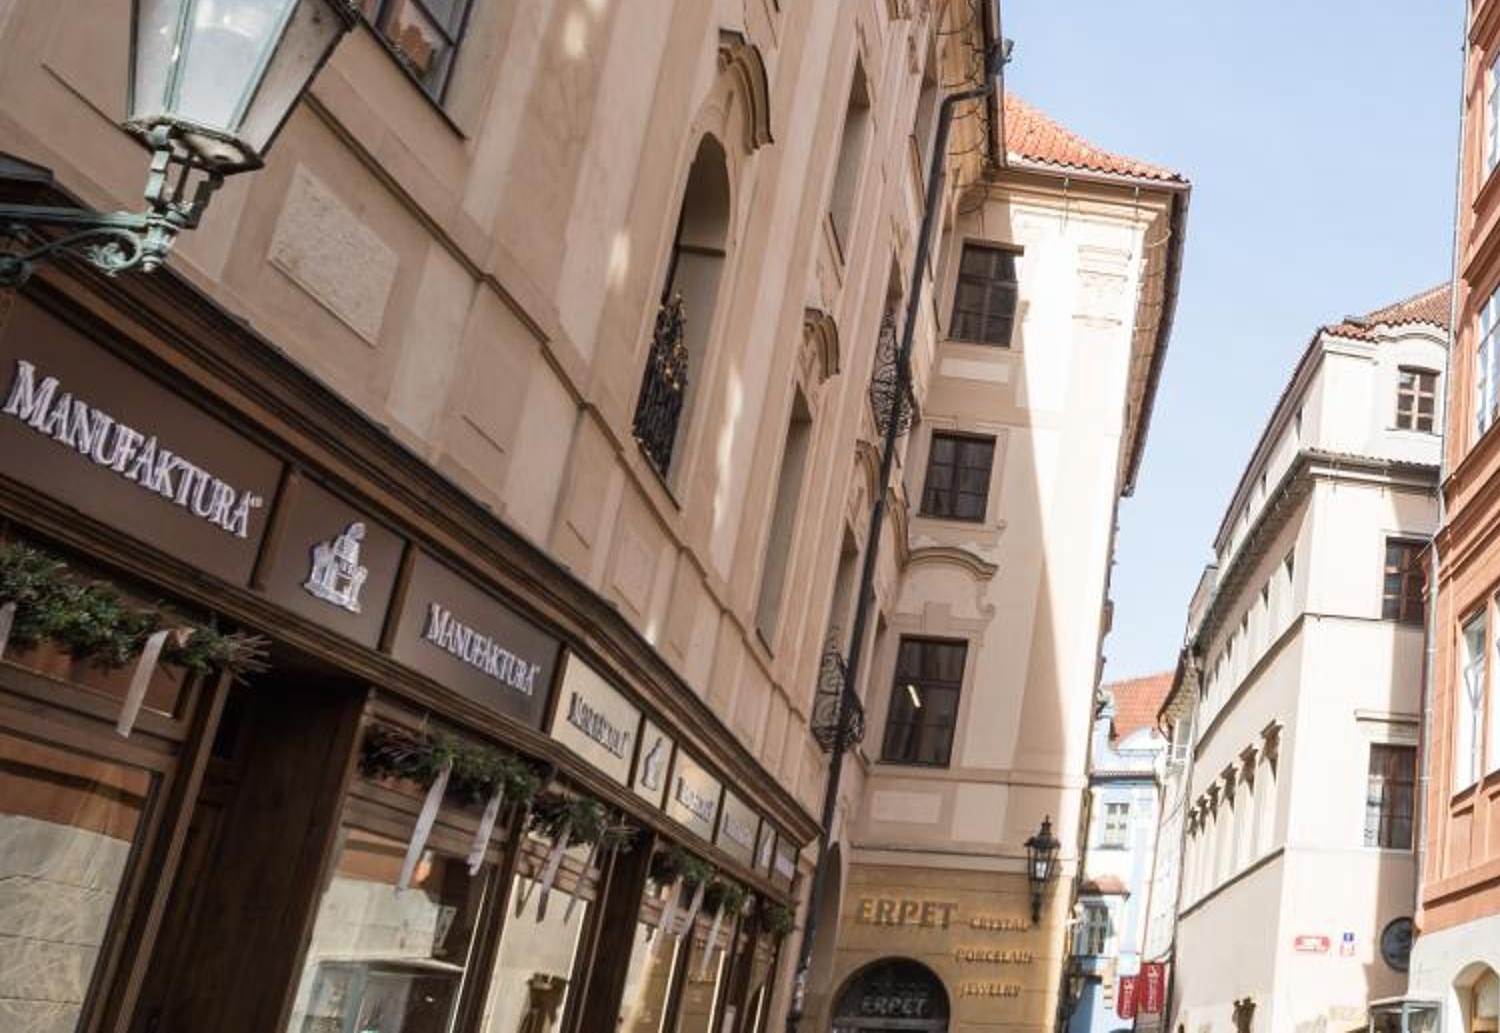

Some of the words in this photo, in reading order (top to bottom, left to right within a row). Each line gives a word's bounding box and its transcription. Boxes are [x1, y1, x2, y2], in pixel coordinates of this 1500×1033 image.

[856, 897, 959, 930] ERPET
[955, 950, 1033, 965] PORCELAIN
[862, 996, 928, 1016] ERPET
